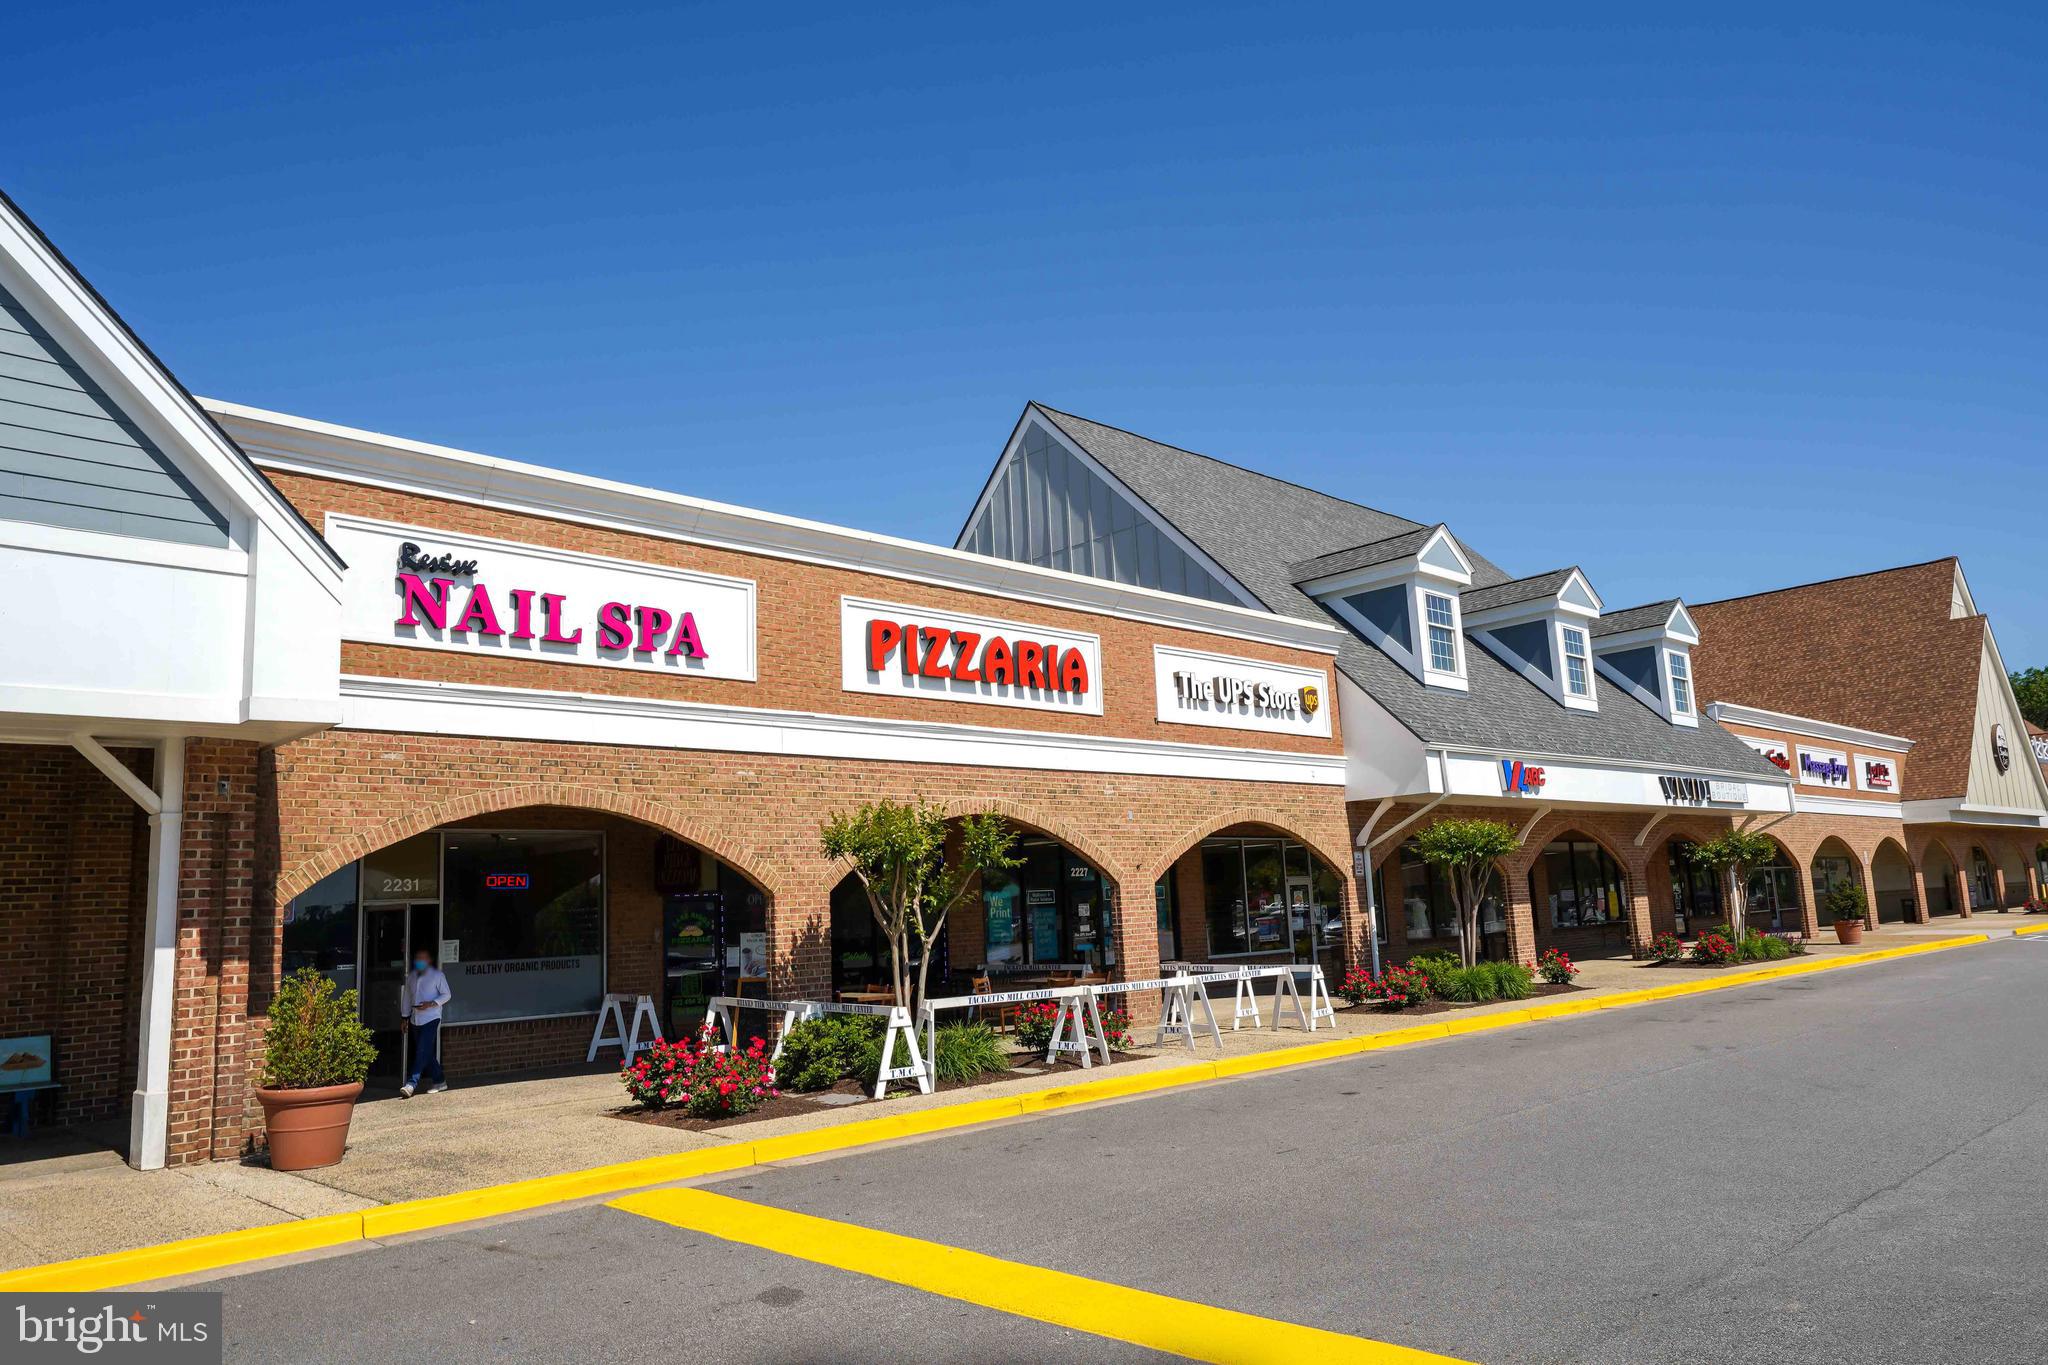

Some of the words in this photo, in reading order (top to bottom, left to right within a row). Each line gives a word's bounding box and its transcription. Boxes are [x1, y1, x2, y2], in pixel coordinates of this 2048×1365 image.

[400, 541, 478, 576] Revive
[395, 573, 583, 643] NAIL
[598, 601, 709, 660] SPA
[866, 619, 1089, 694] PIZZARIA
[1174, 671, 1214, 701] The
[1214, 676, 1254, 705] UPS
[1255, 682, 1300, 711] Store
[1524, 767, 1546, 787] ABC
[1715, 782, 1741, 792] BRIDAL
[1711, 791, 1747, 802] BOUTIQUE
[1070, 867, 1088, 877] 2227
[383, 878, 420, 893] 2231
[485, 875, 528, 888] OPEN
[989, 896, 1003, 907] We
[990, 908, 1011, 919] Print
[466, 963, 502, 975] HEALTHY
[503, 961, 539, 973] ORGANIC
[540, 959, 580, 972] PRODUCTS
[1228, 971, 1241, 979] MILL
[1241, 970, 1262, 978] CENTER
[1101, 983, 1130, 993] TACKETTS
[1131, 982, 1146, 990] MILL
[1146, 980, 1169, 989] CENTER
[968, 992, 1005, 1005] TACKETTS
[1006, 992, 1025, 1001] MILL
[1026, 990, 1053, 1000] CENTER
[841, 1003, 853, 1012] MILL
[854, 1004, 873, 1013] CENTER
[1057, 1042, 1079, 1051] T.M.C.
[890, 1067, 917, 1079] T.M.C.
